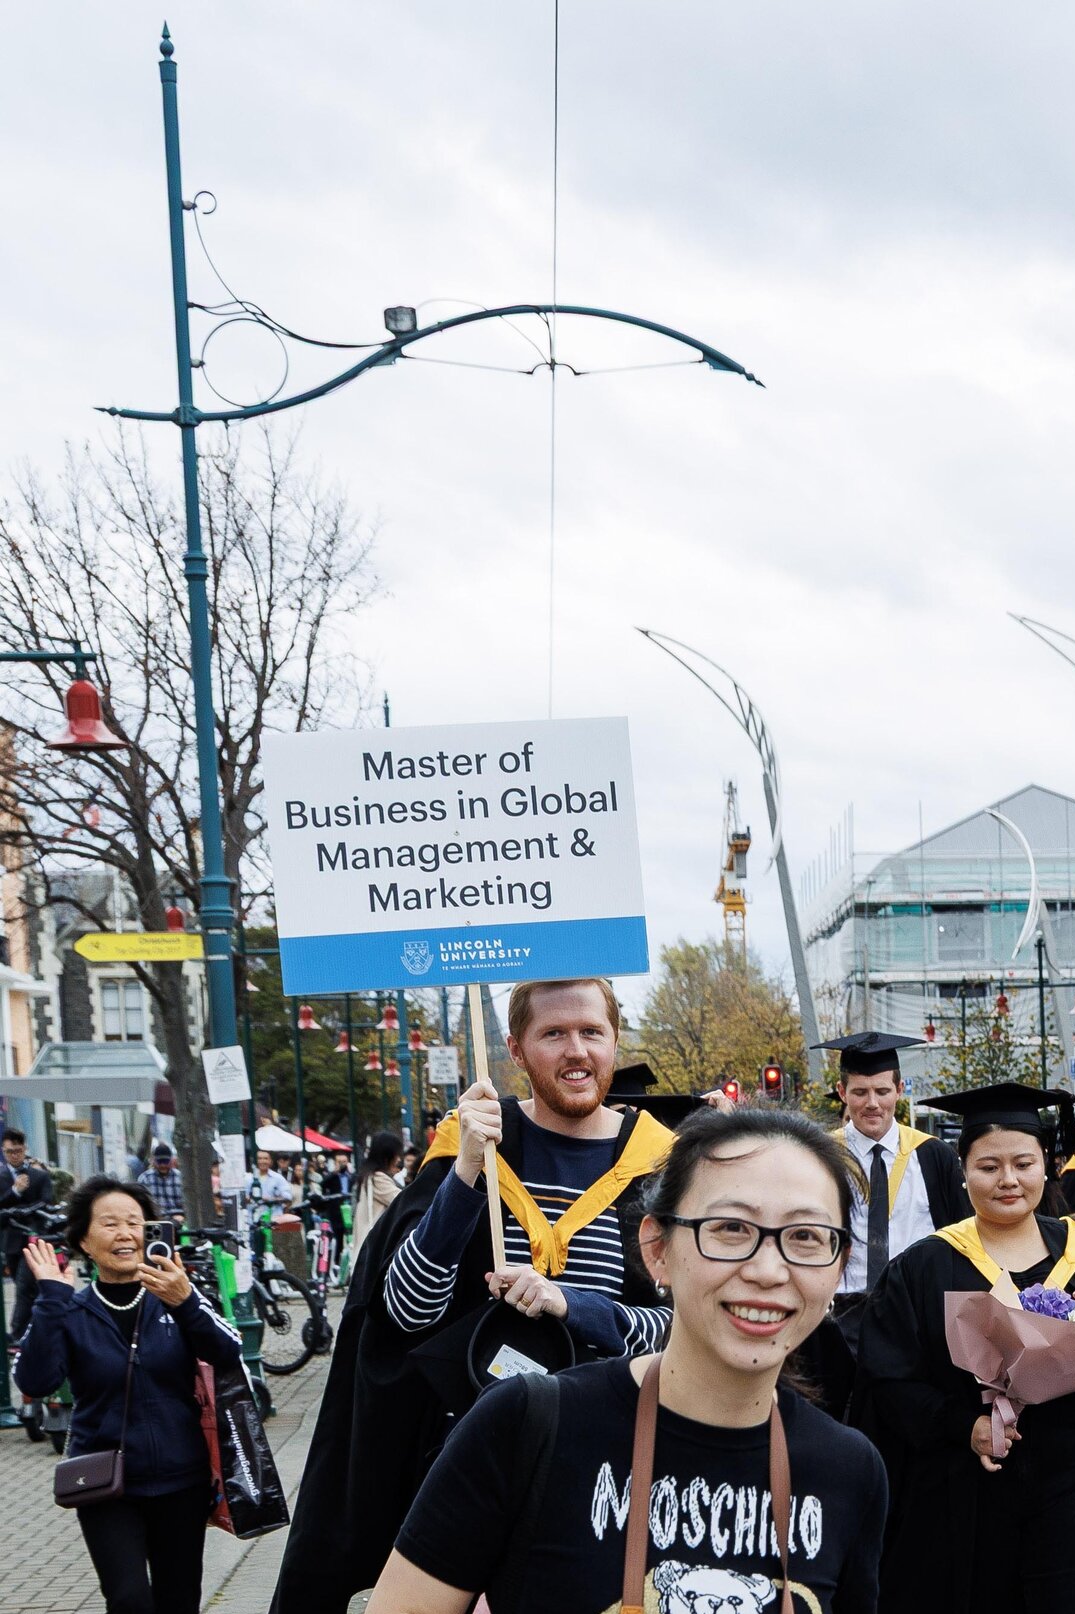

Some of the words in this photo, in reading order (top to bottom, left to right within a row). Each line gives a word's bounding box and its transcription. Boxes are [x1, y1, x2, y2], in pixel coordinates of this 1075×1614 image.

[362, 751, 488, 782] Master
[499, 741, 535, 774] of
[285, 796, 448, 830] Business
[457, 789, 490, 820] in
[500, 781, 619, 818] Global
[316, 832, 560, 873] Management
[570, 828, 597, 858] &
[368, 874, 553, 913] Marketing
[439, 939, 503, 952] LINCOLN
[440, 948, 532, 962] UNIVERSITY
